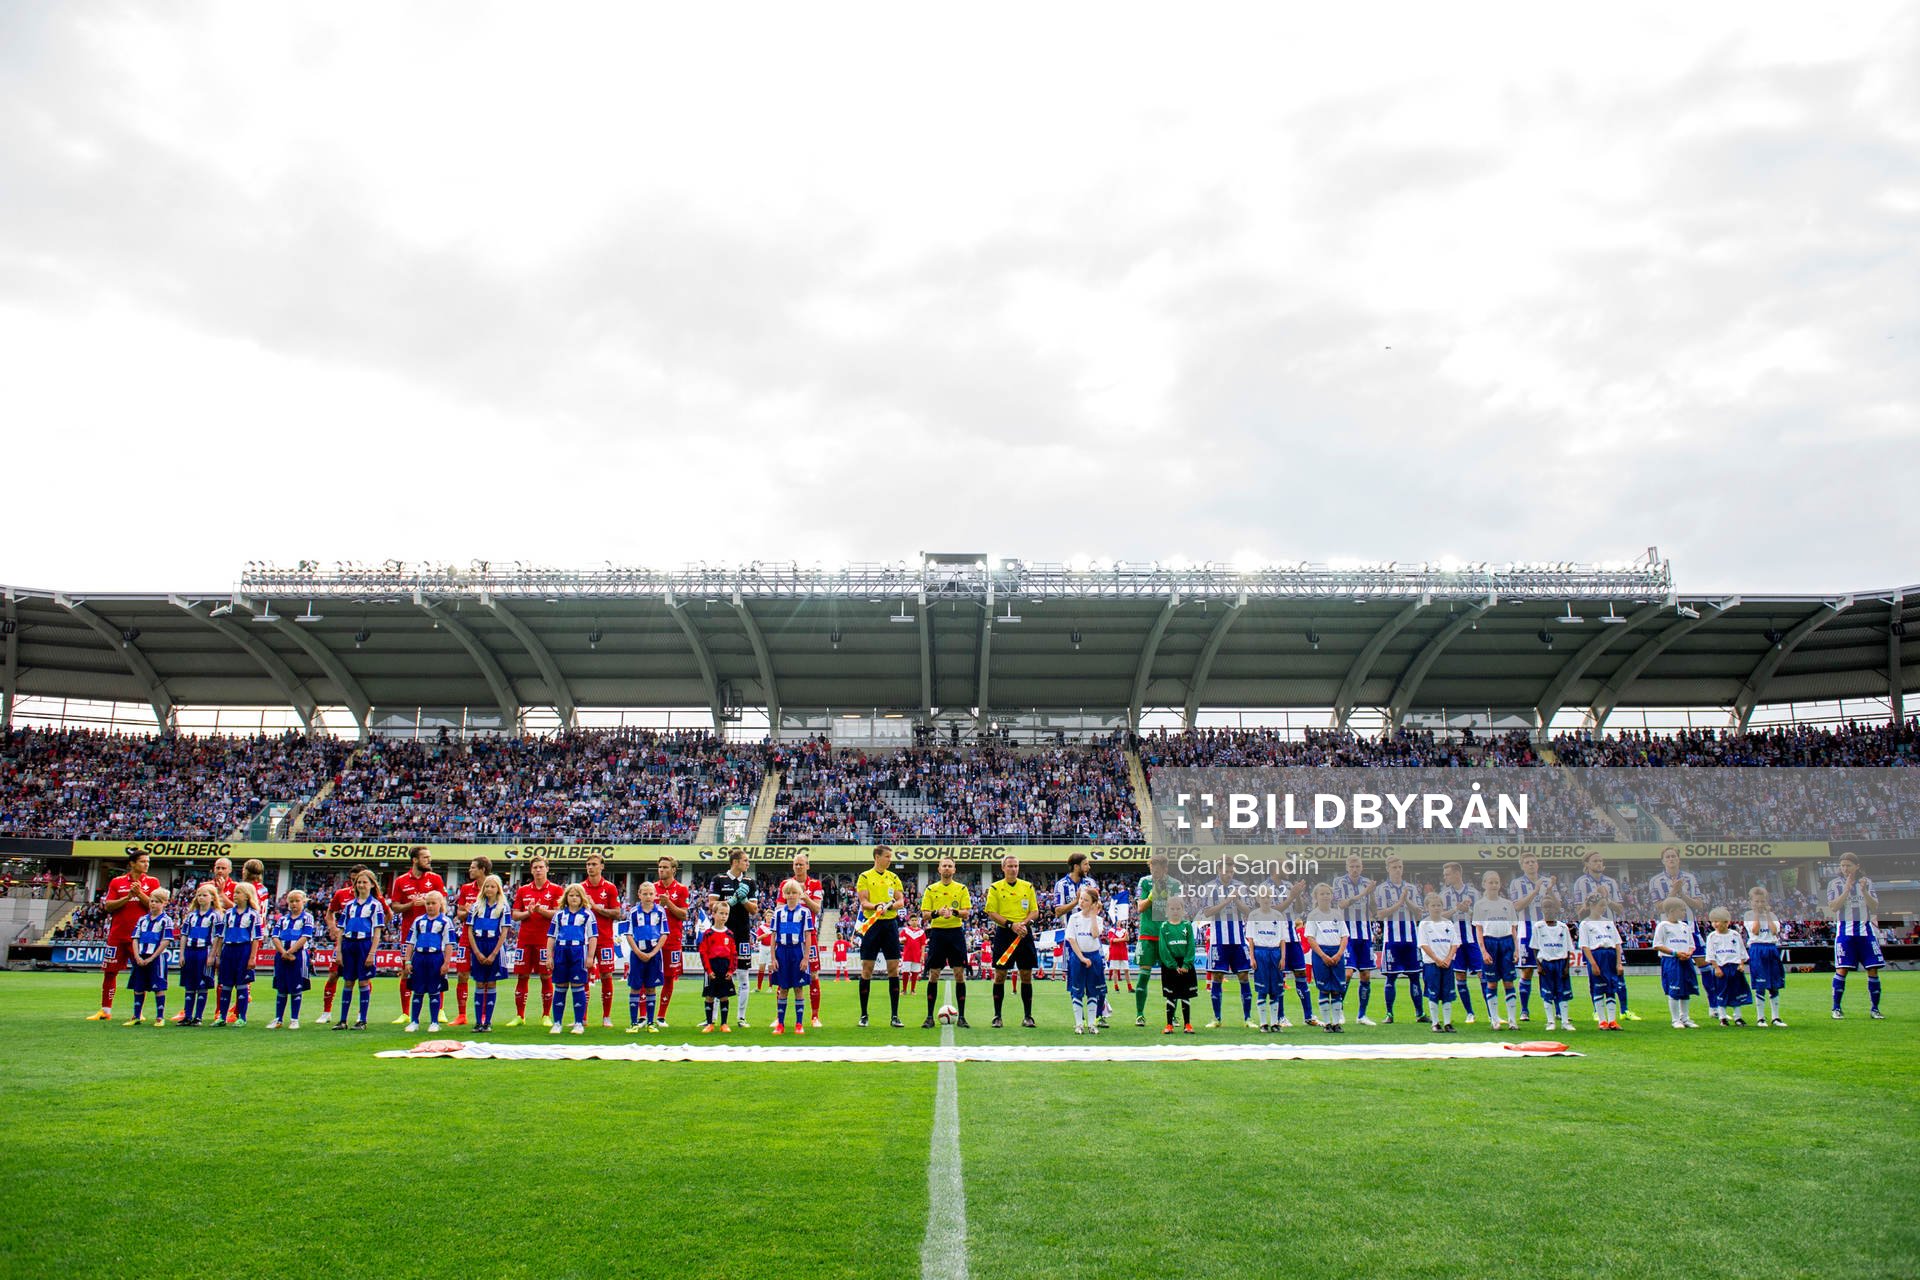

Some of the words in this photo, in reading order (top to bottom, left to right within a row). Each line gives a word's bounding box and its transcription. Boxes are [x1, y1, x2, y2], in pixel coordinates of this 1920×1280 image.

[142, 843, 232, 856] SOHLBERG
[330, 845, 411, 858] SOHLBER
[913, 847, 1006, 860] SOHLBERG
[1684, 843, 1772, 856] SOHLBERG
